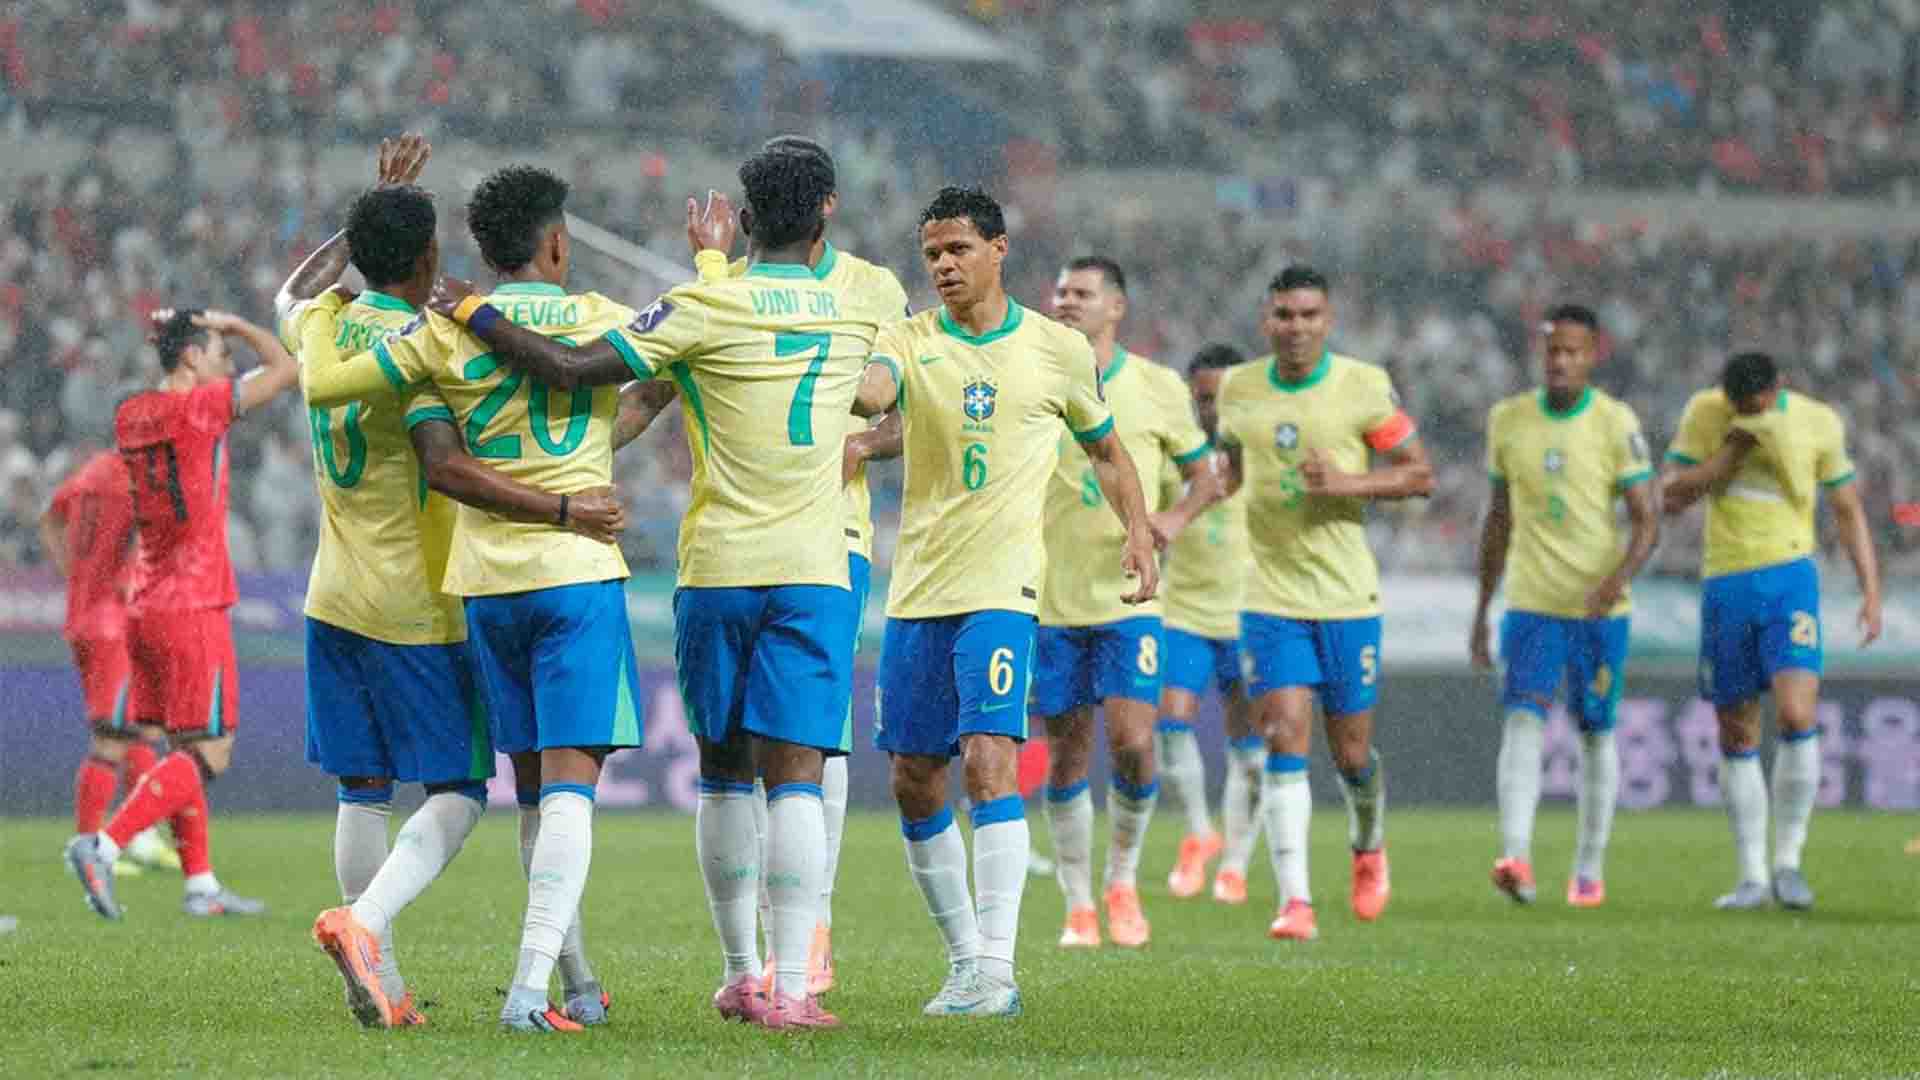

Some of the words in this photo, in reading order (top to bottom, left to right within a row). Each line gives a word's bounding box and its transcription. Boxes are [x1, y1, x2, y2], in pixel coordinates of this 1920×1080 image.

[748, 290, 799, 316] VINI
[464, 337, 592, 457] 20
[774, 332, 831, 445] 7
[962, 443, 988, 492] 6
[988, 647, 1014, 696] 6
[1137, 635, 1158, 676] 8
[1360, 644, 1377, 686] 5
